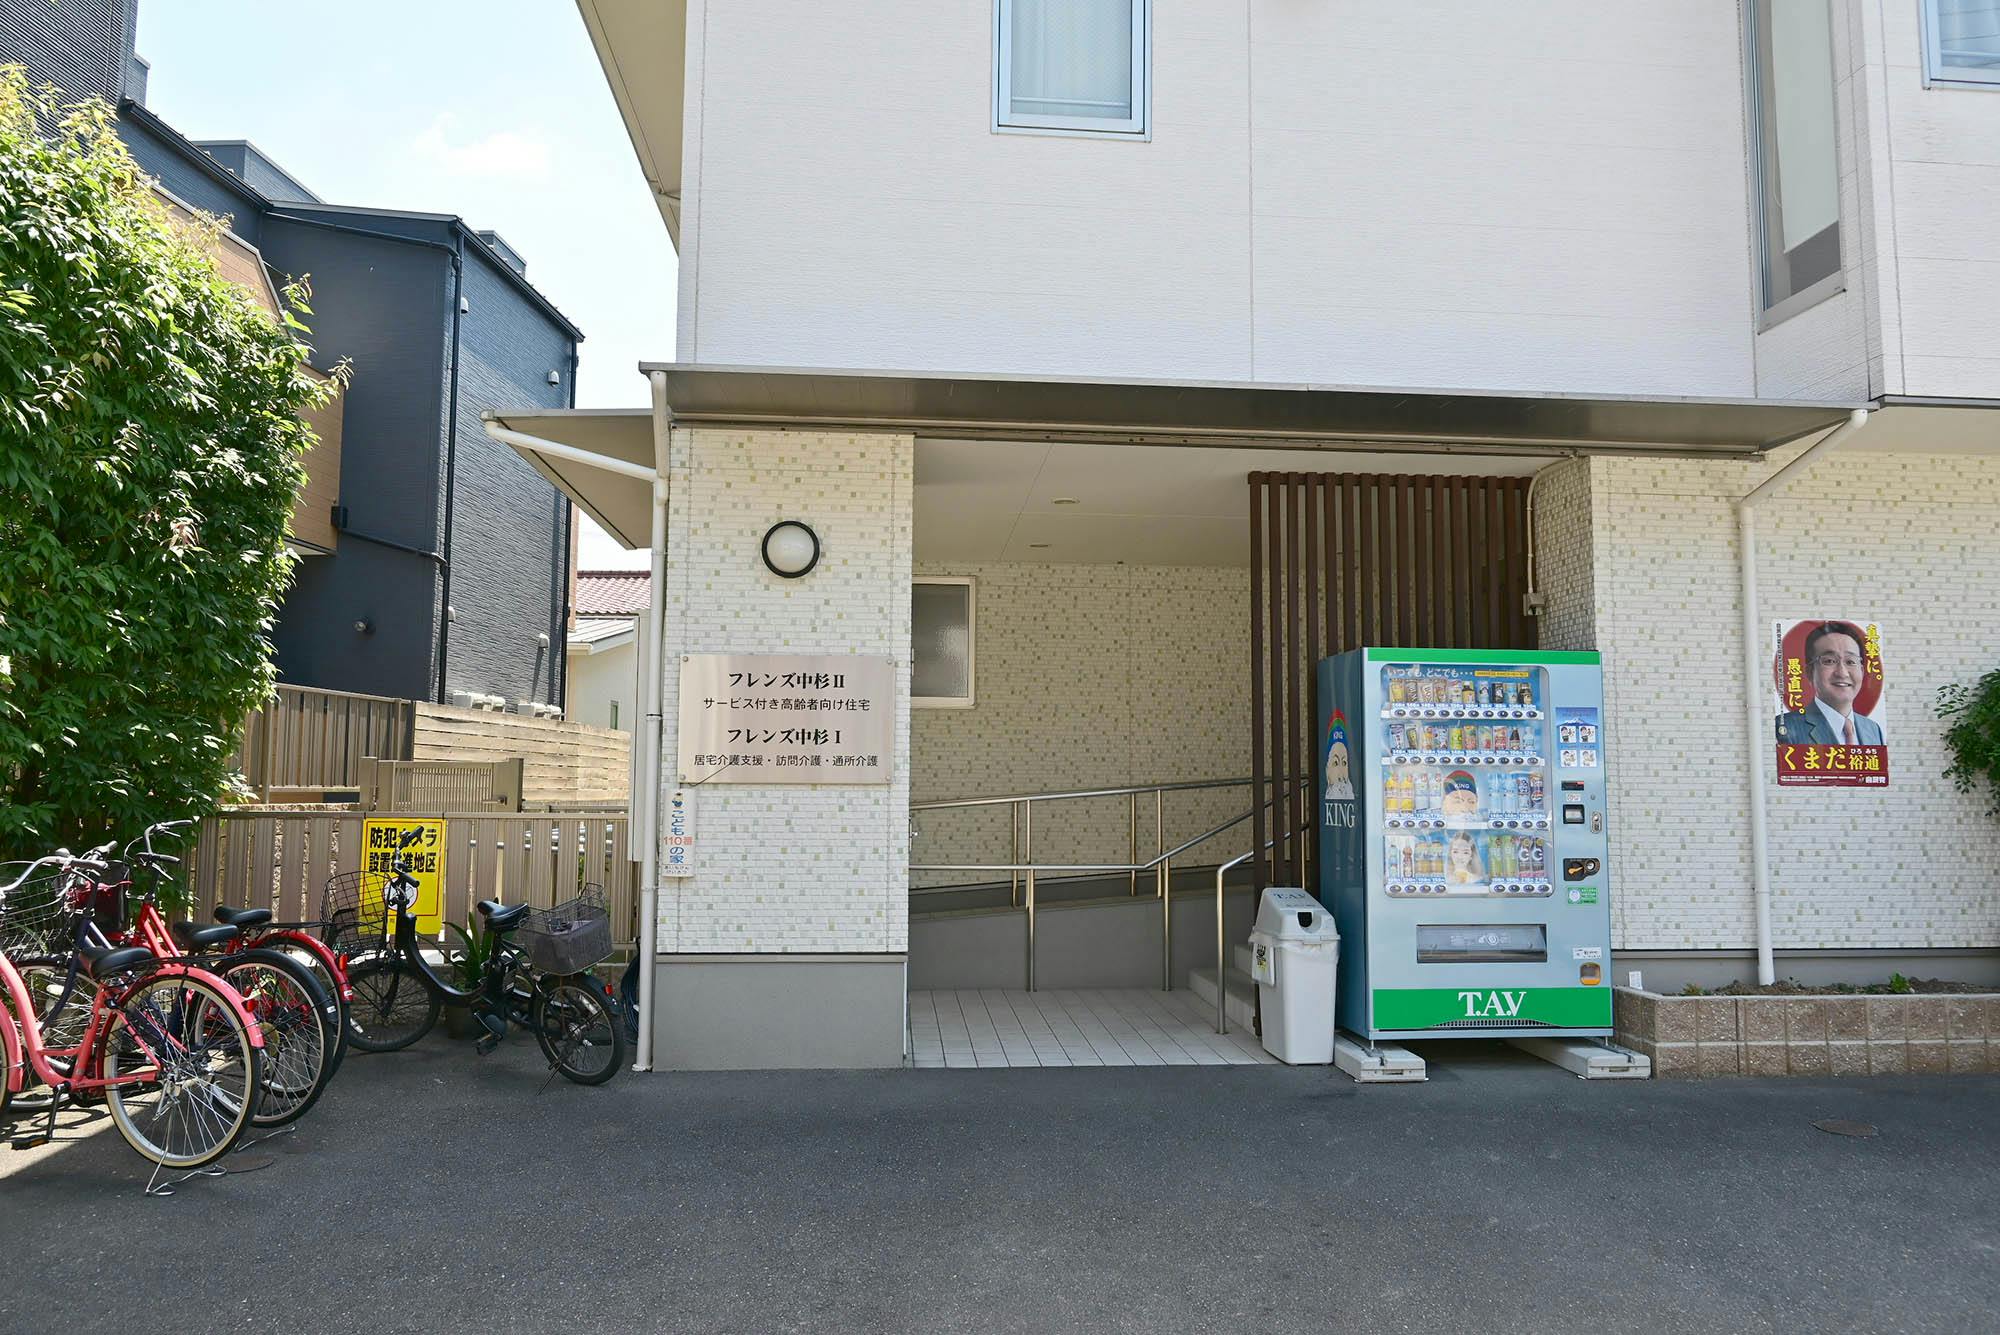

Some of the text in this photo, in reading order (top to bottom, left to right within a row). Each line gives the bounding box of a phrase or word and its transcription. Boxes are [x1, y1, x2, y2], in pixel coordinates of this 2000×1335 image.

[1864, 624, 1882, 681] 真摯に。
[703, 697, 870, 711] サービス付き高齢者向け住宅
[1786, 658, 1805, 715] 愚直に。
[1325, 802, 1355, 828] KING
